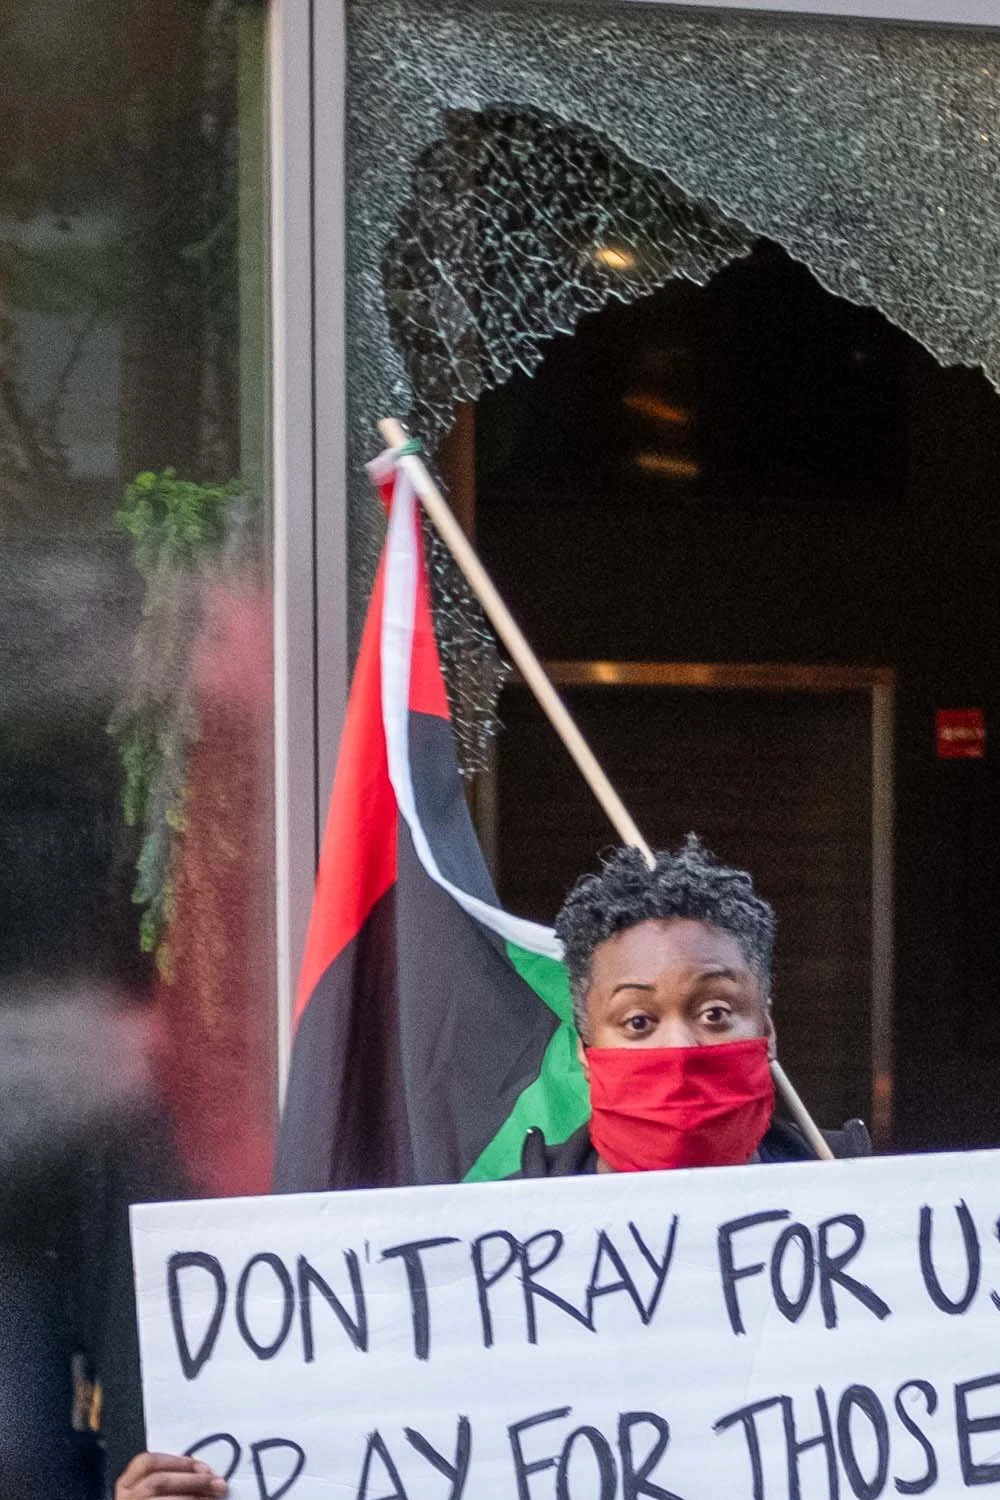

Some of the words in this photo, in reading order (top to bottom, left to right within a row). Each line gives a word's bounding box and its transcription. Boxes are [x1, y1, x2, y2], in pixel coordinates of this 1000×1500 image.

[167, 1236, 461, 1380] DON'T
[470, 1214, 680, 1348] PRAY
[717, 1209, 892, 1336] FOR
